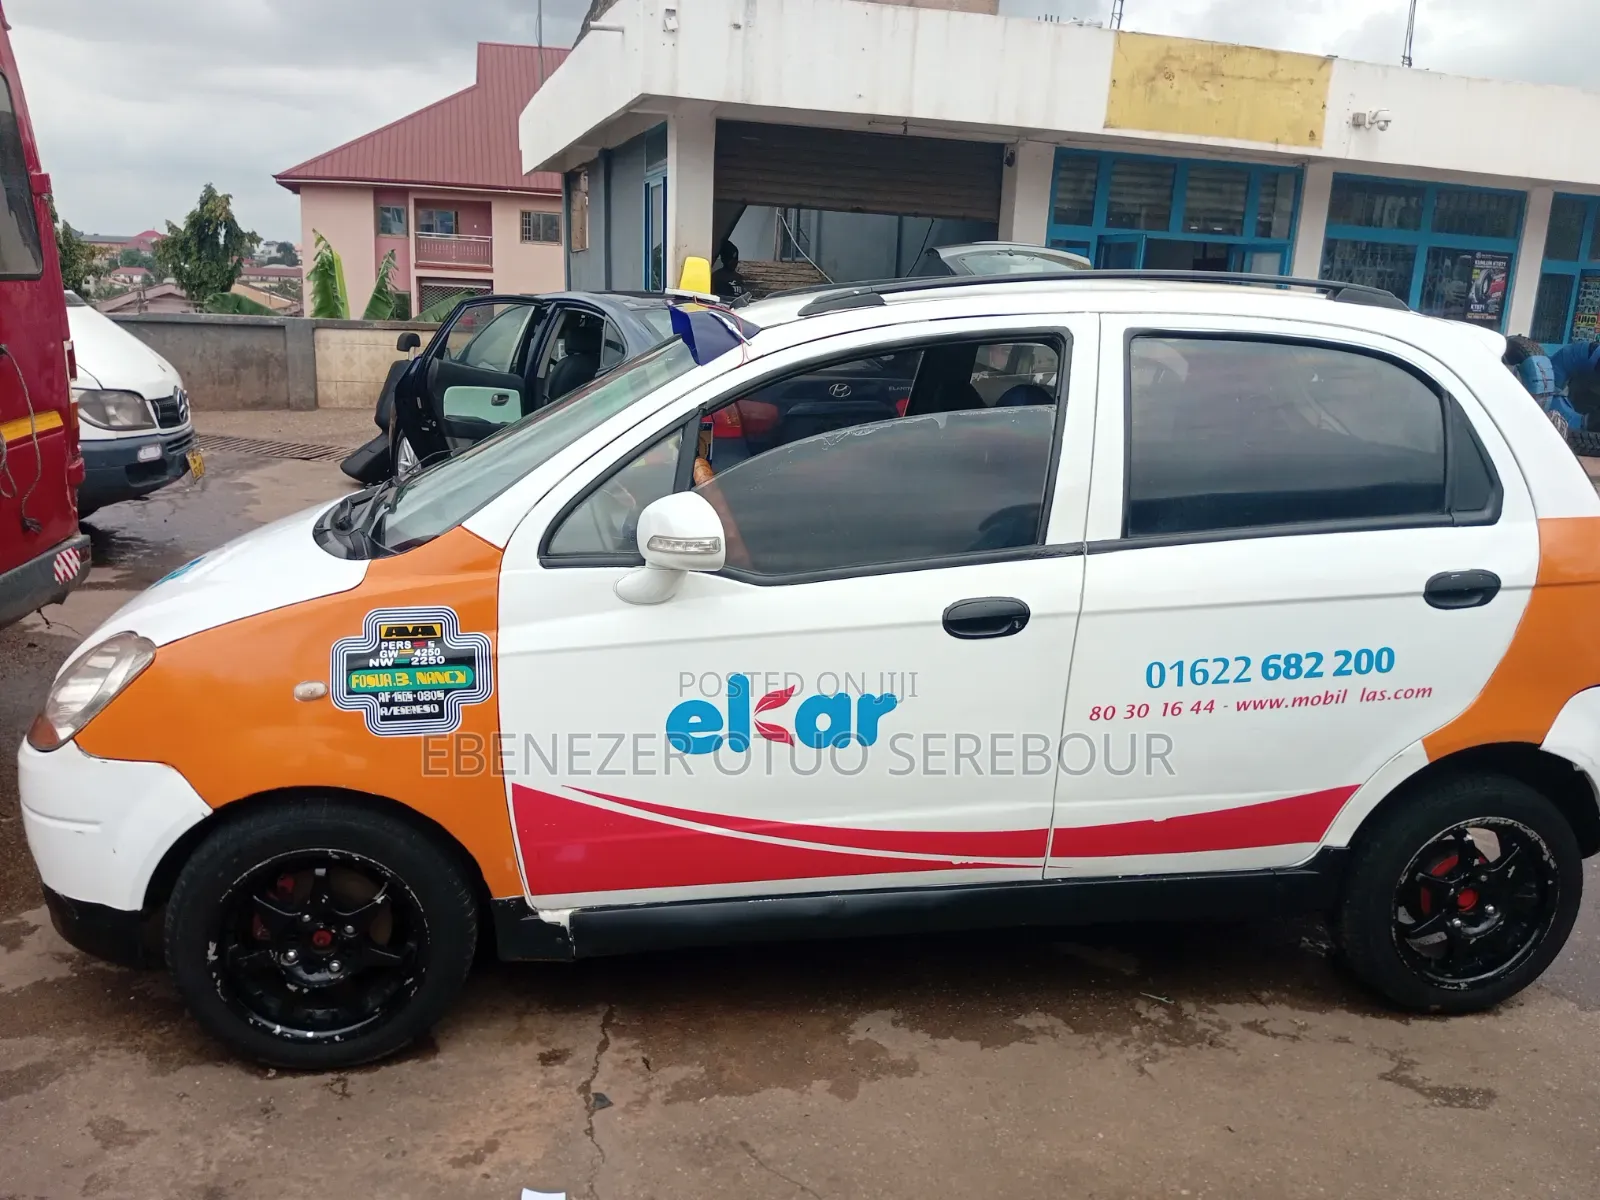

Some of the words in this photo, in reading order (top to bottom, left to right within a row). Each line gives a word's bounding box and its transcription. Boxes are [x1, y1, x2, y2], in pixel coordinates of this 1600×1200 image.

[381, 641, 411, 650] PERS
[379, 650, 398, 658] GW
[414, 648, 441, 657] 4250
[369, 658, 394, 667] NW
[410, 656, 445, 666] 2250
[1145, 655, 1252, 689] 01622
[1260, 651, 1325, 682] 682
[1332, 646, 1396, 677] 200
[415, 671, 467, 685] NANCY
[378, 691, 391, 702] AF
[1088, 705, 1116, 721] 80
[1123, 703, 1150, 719] 30
[1161, 701, 1184, 717] 16
[1189, 699, 1215, 715] 44
